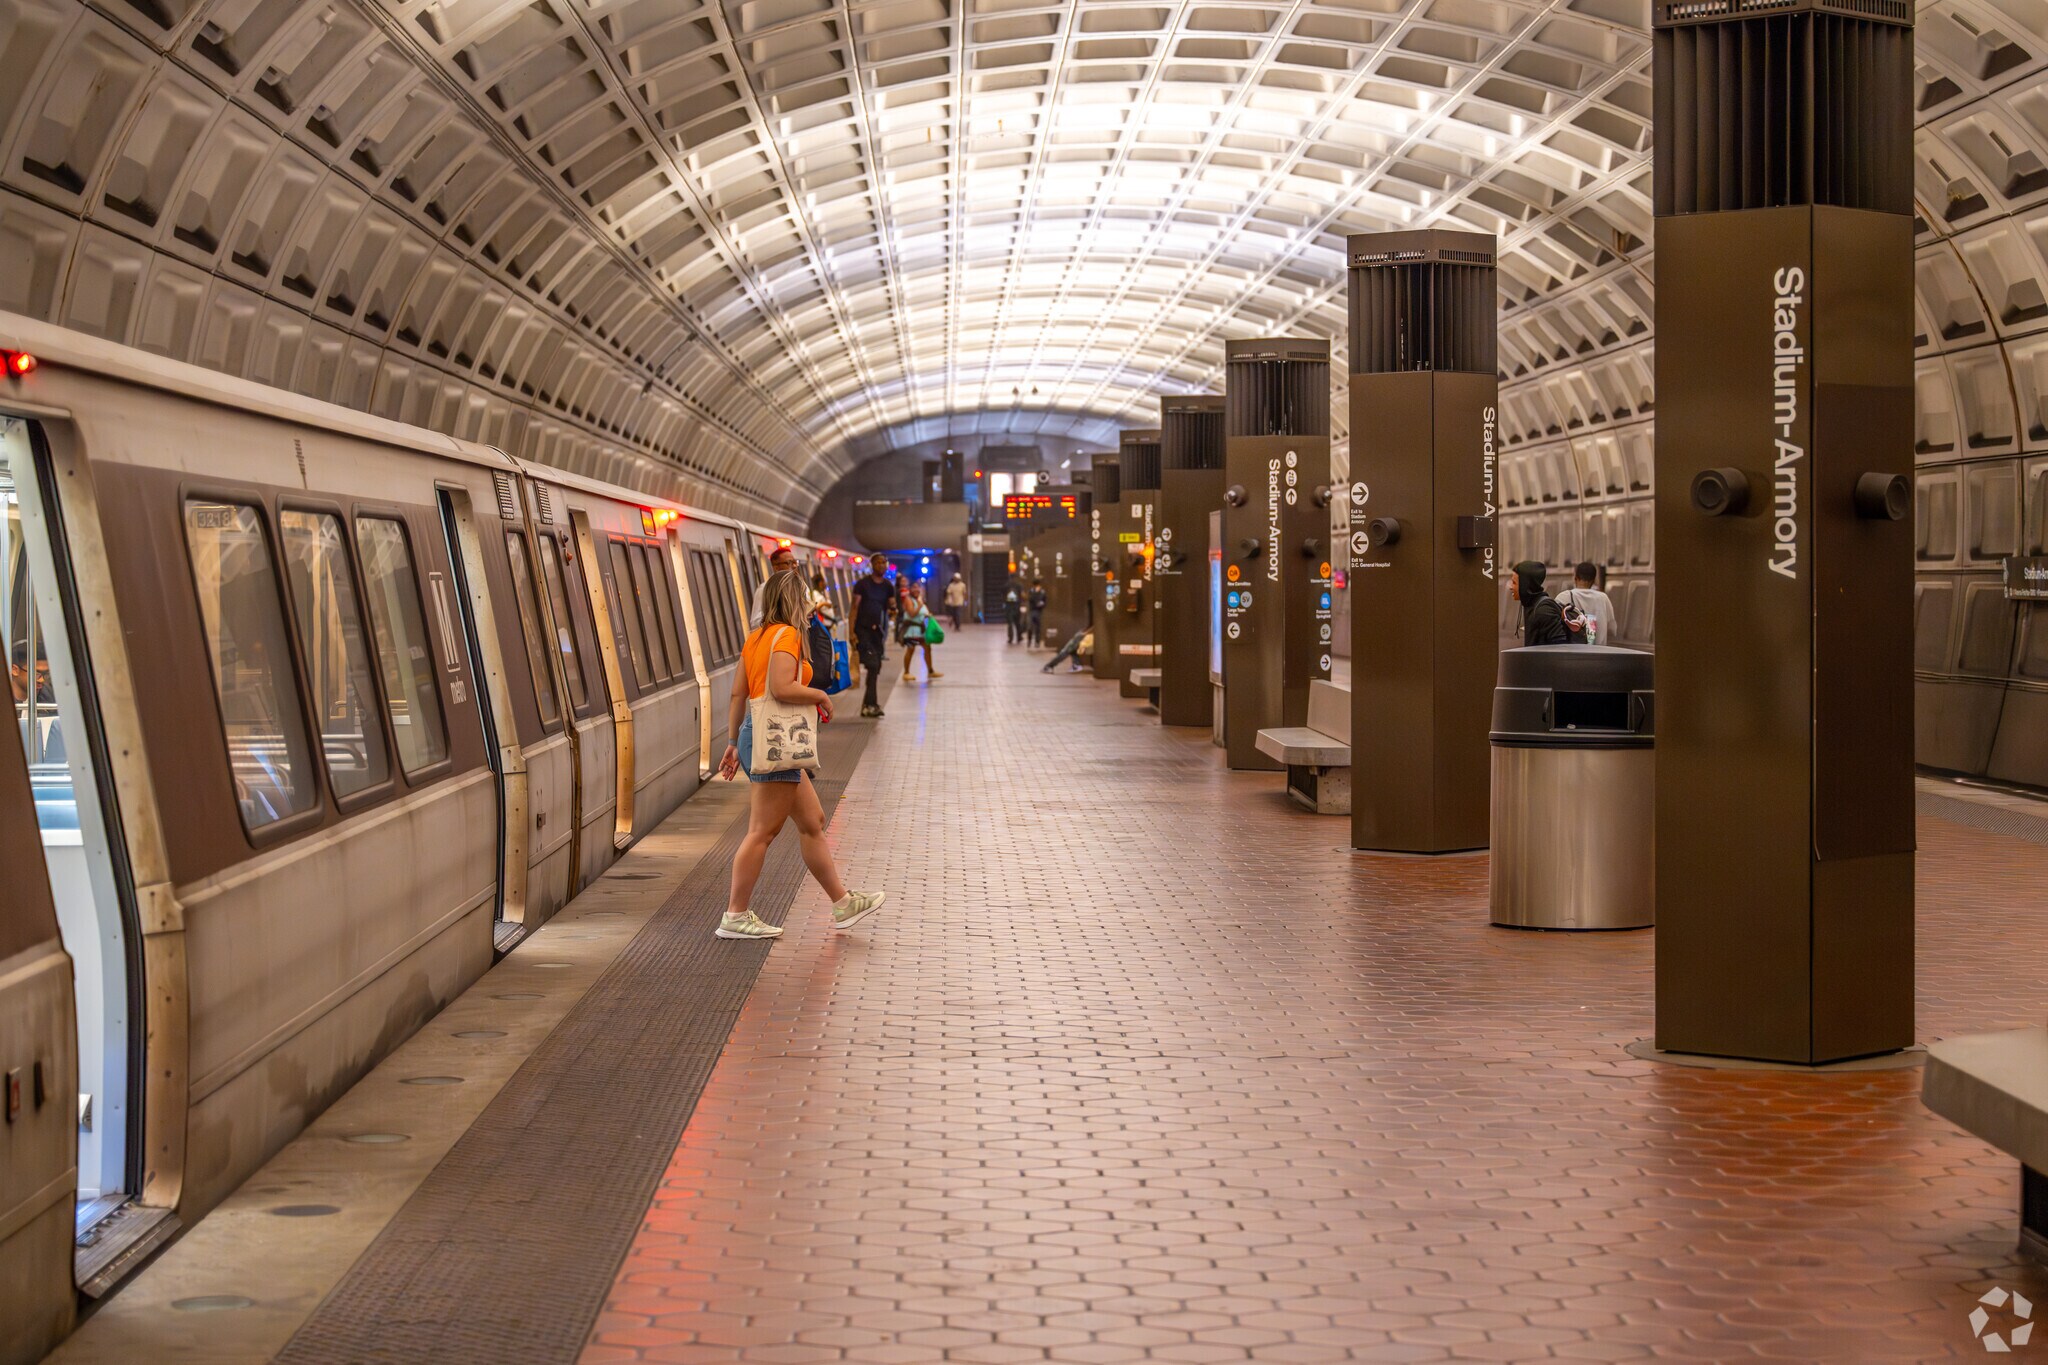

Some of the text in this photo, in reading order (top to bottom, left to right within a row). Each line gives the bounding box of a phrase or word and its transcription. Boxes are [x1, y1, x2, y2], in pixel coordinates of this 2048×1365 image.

[1482, 406, 1496, 579] Stadium-Aory
[1768, 267, 1804, 580] Stadium-Armory
[1267, 458, 1281, 582] Stadium-Armory
[450, 675, 467, 704] metro
